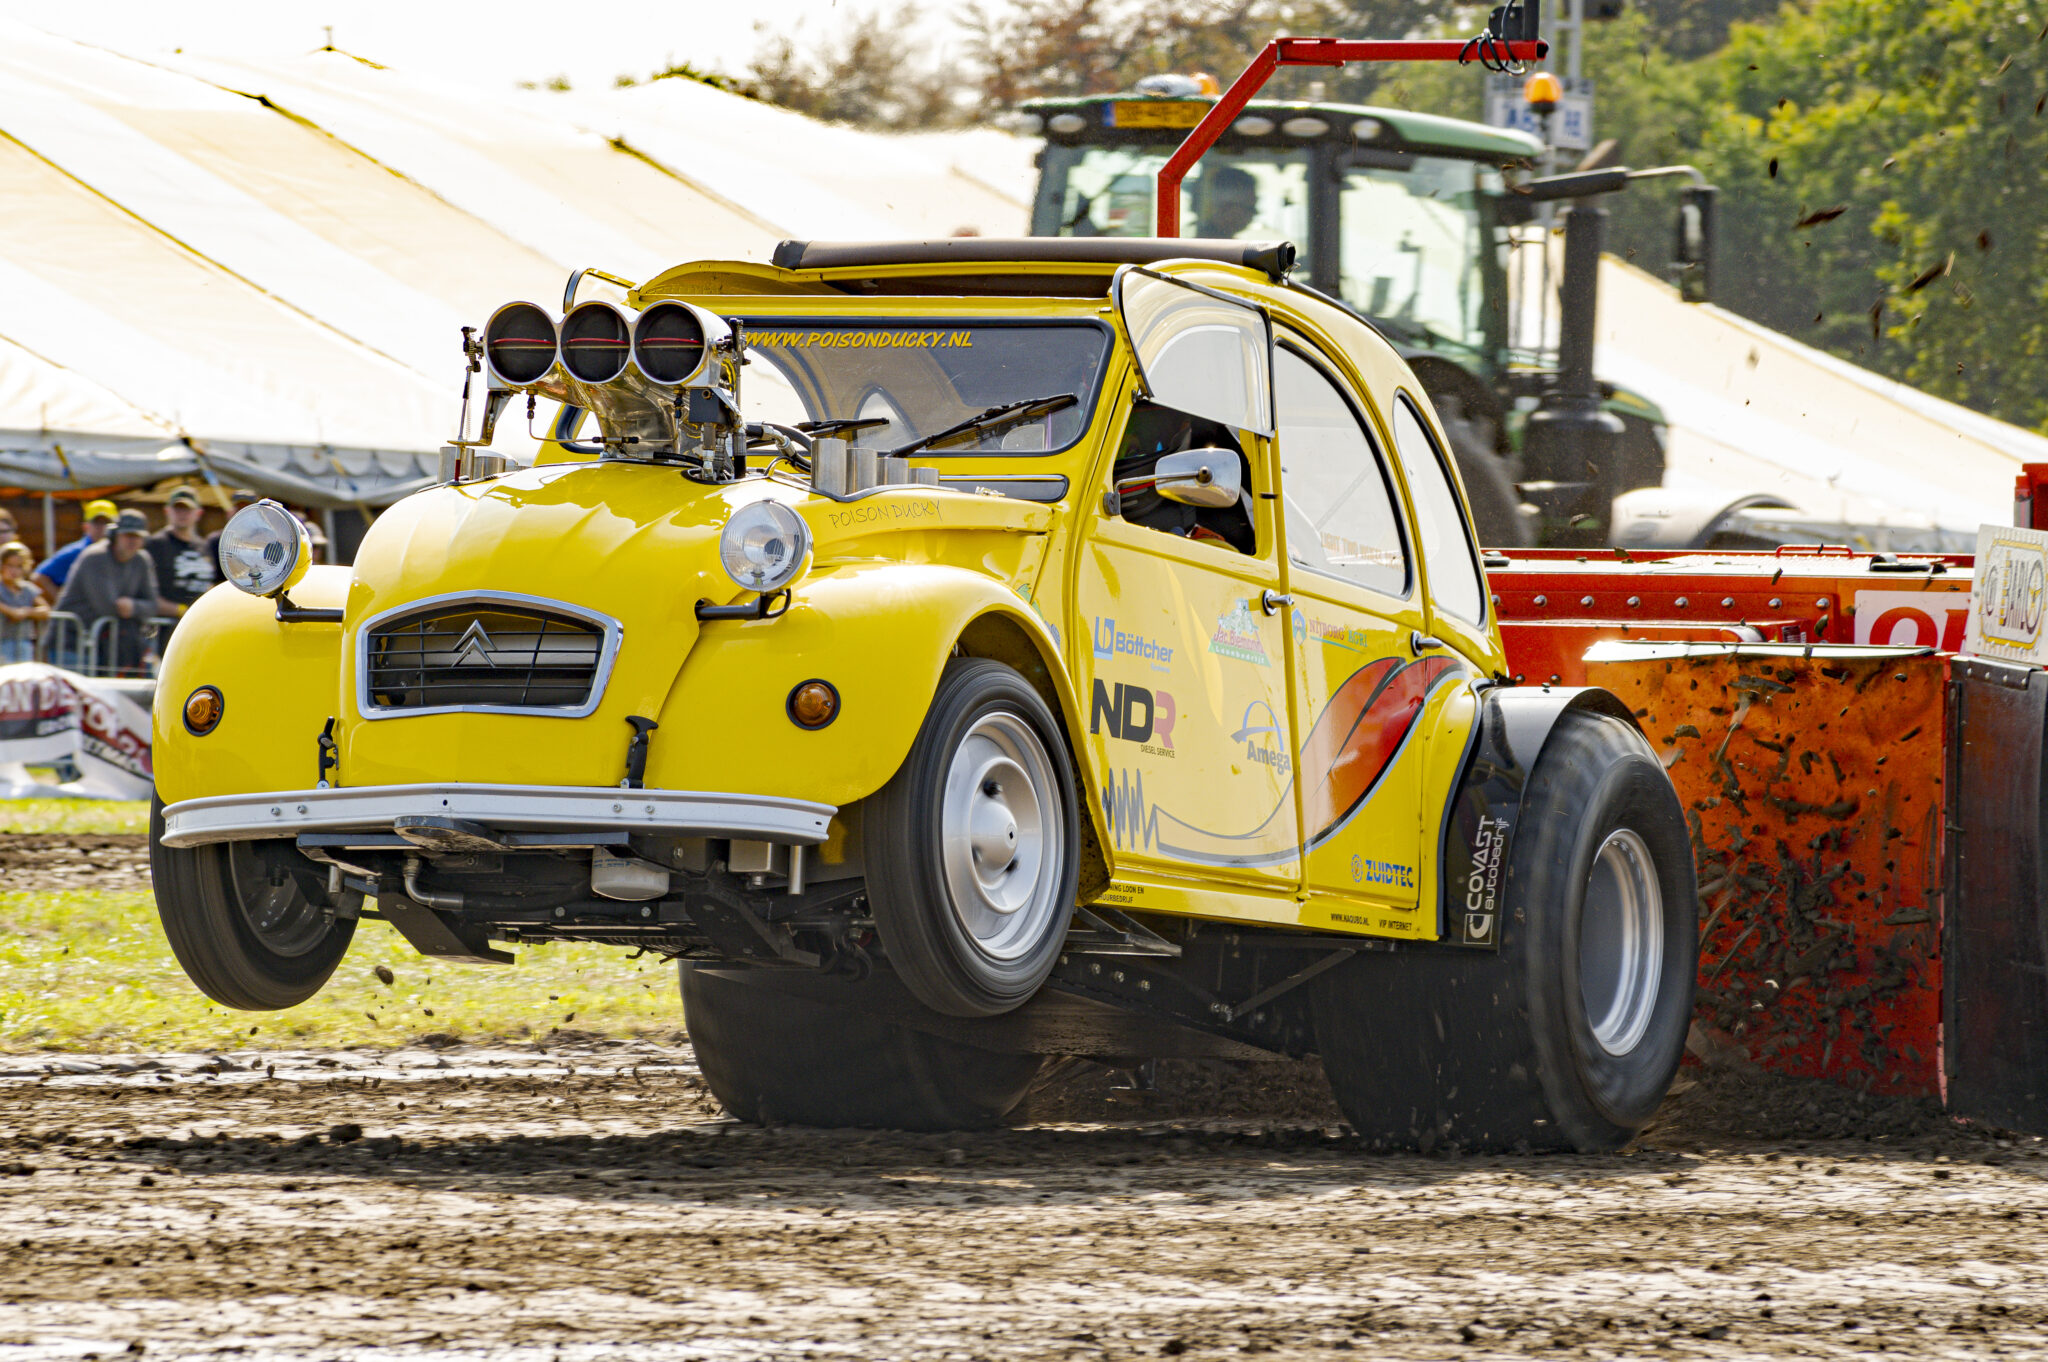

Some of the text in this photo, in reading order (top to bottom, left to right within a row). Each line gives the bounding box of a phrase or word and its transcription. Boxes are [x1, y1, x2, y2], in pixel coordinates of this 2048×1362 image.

[745, 331, 973, 348] WWW.POISONDUCKY.NL
[1115, 631, 1174, 663] Böttcher
[1090, 678, 1176, 749] NDR
[1247, 740, 1292, 775] Amega
[1365, 859, 1414, 888] ZUIDTEC
[1466, 814, 1494, 911] COVAST
[1485, 817, 1510, 911] autobedrijf
